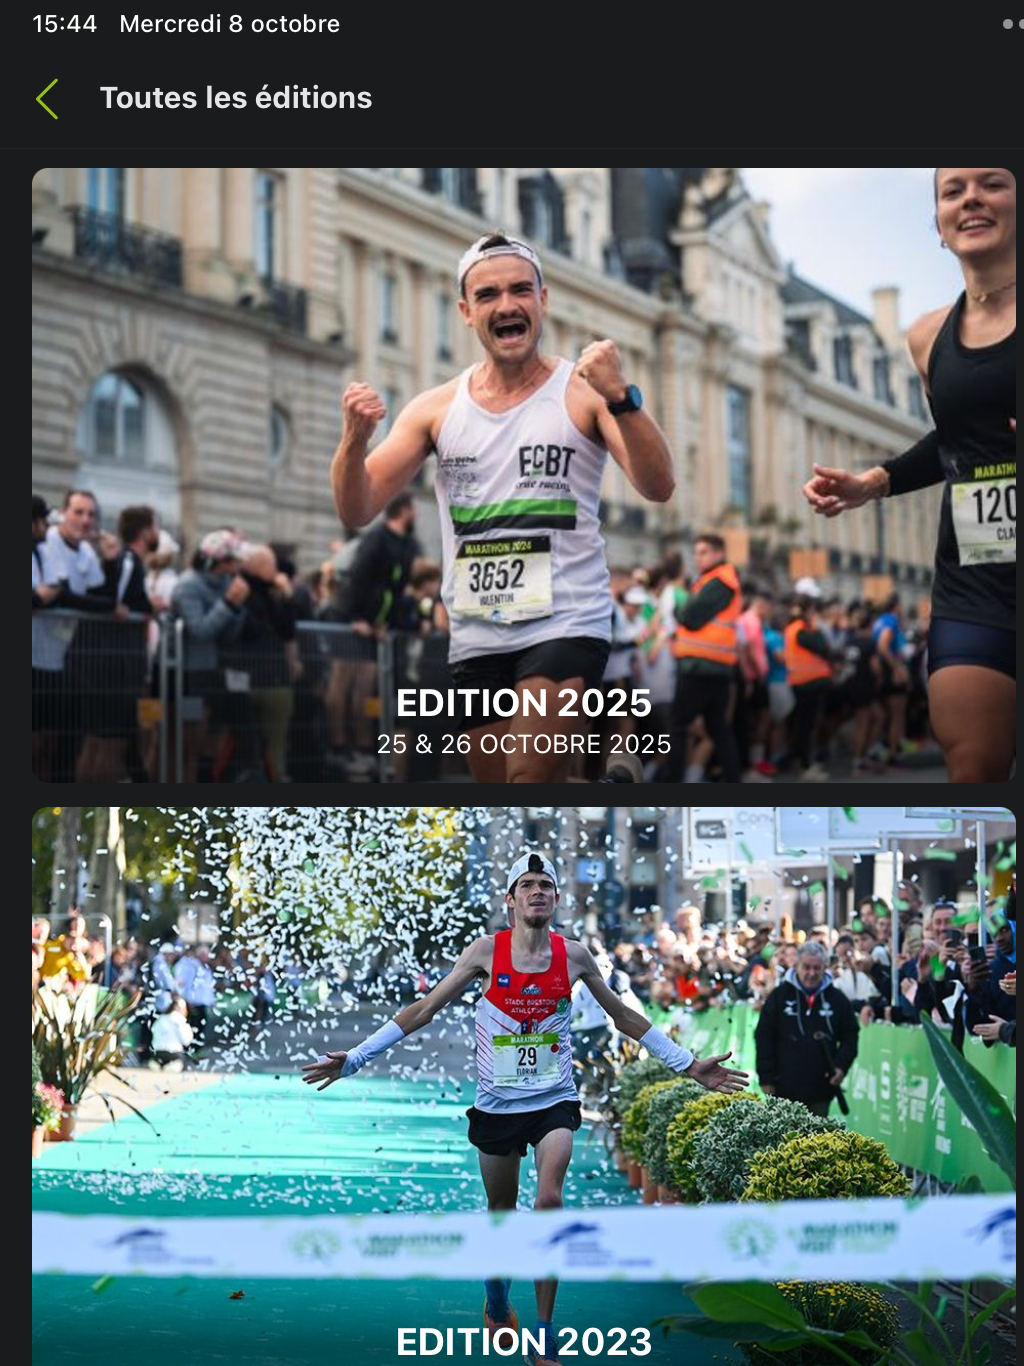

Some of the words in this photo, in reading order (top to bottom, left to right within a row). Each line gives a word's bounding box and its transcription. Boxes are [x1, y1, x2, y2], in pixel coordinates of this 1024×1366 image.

[32, 14, 98, 33] 15:44
[120, 13, 221, 33] Mercredi
[229, 14, 242, 33] 8
[251, 13, 340, 33] octobre
[100, 86, 198, 109] Toutes
[206, 85, 248, 109] les
[255, 83, 373, 109] éditions
[469, 558, 525, 593] 3652
[518, 1047, 537, 1066] 29
